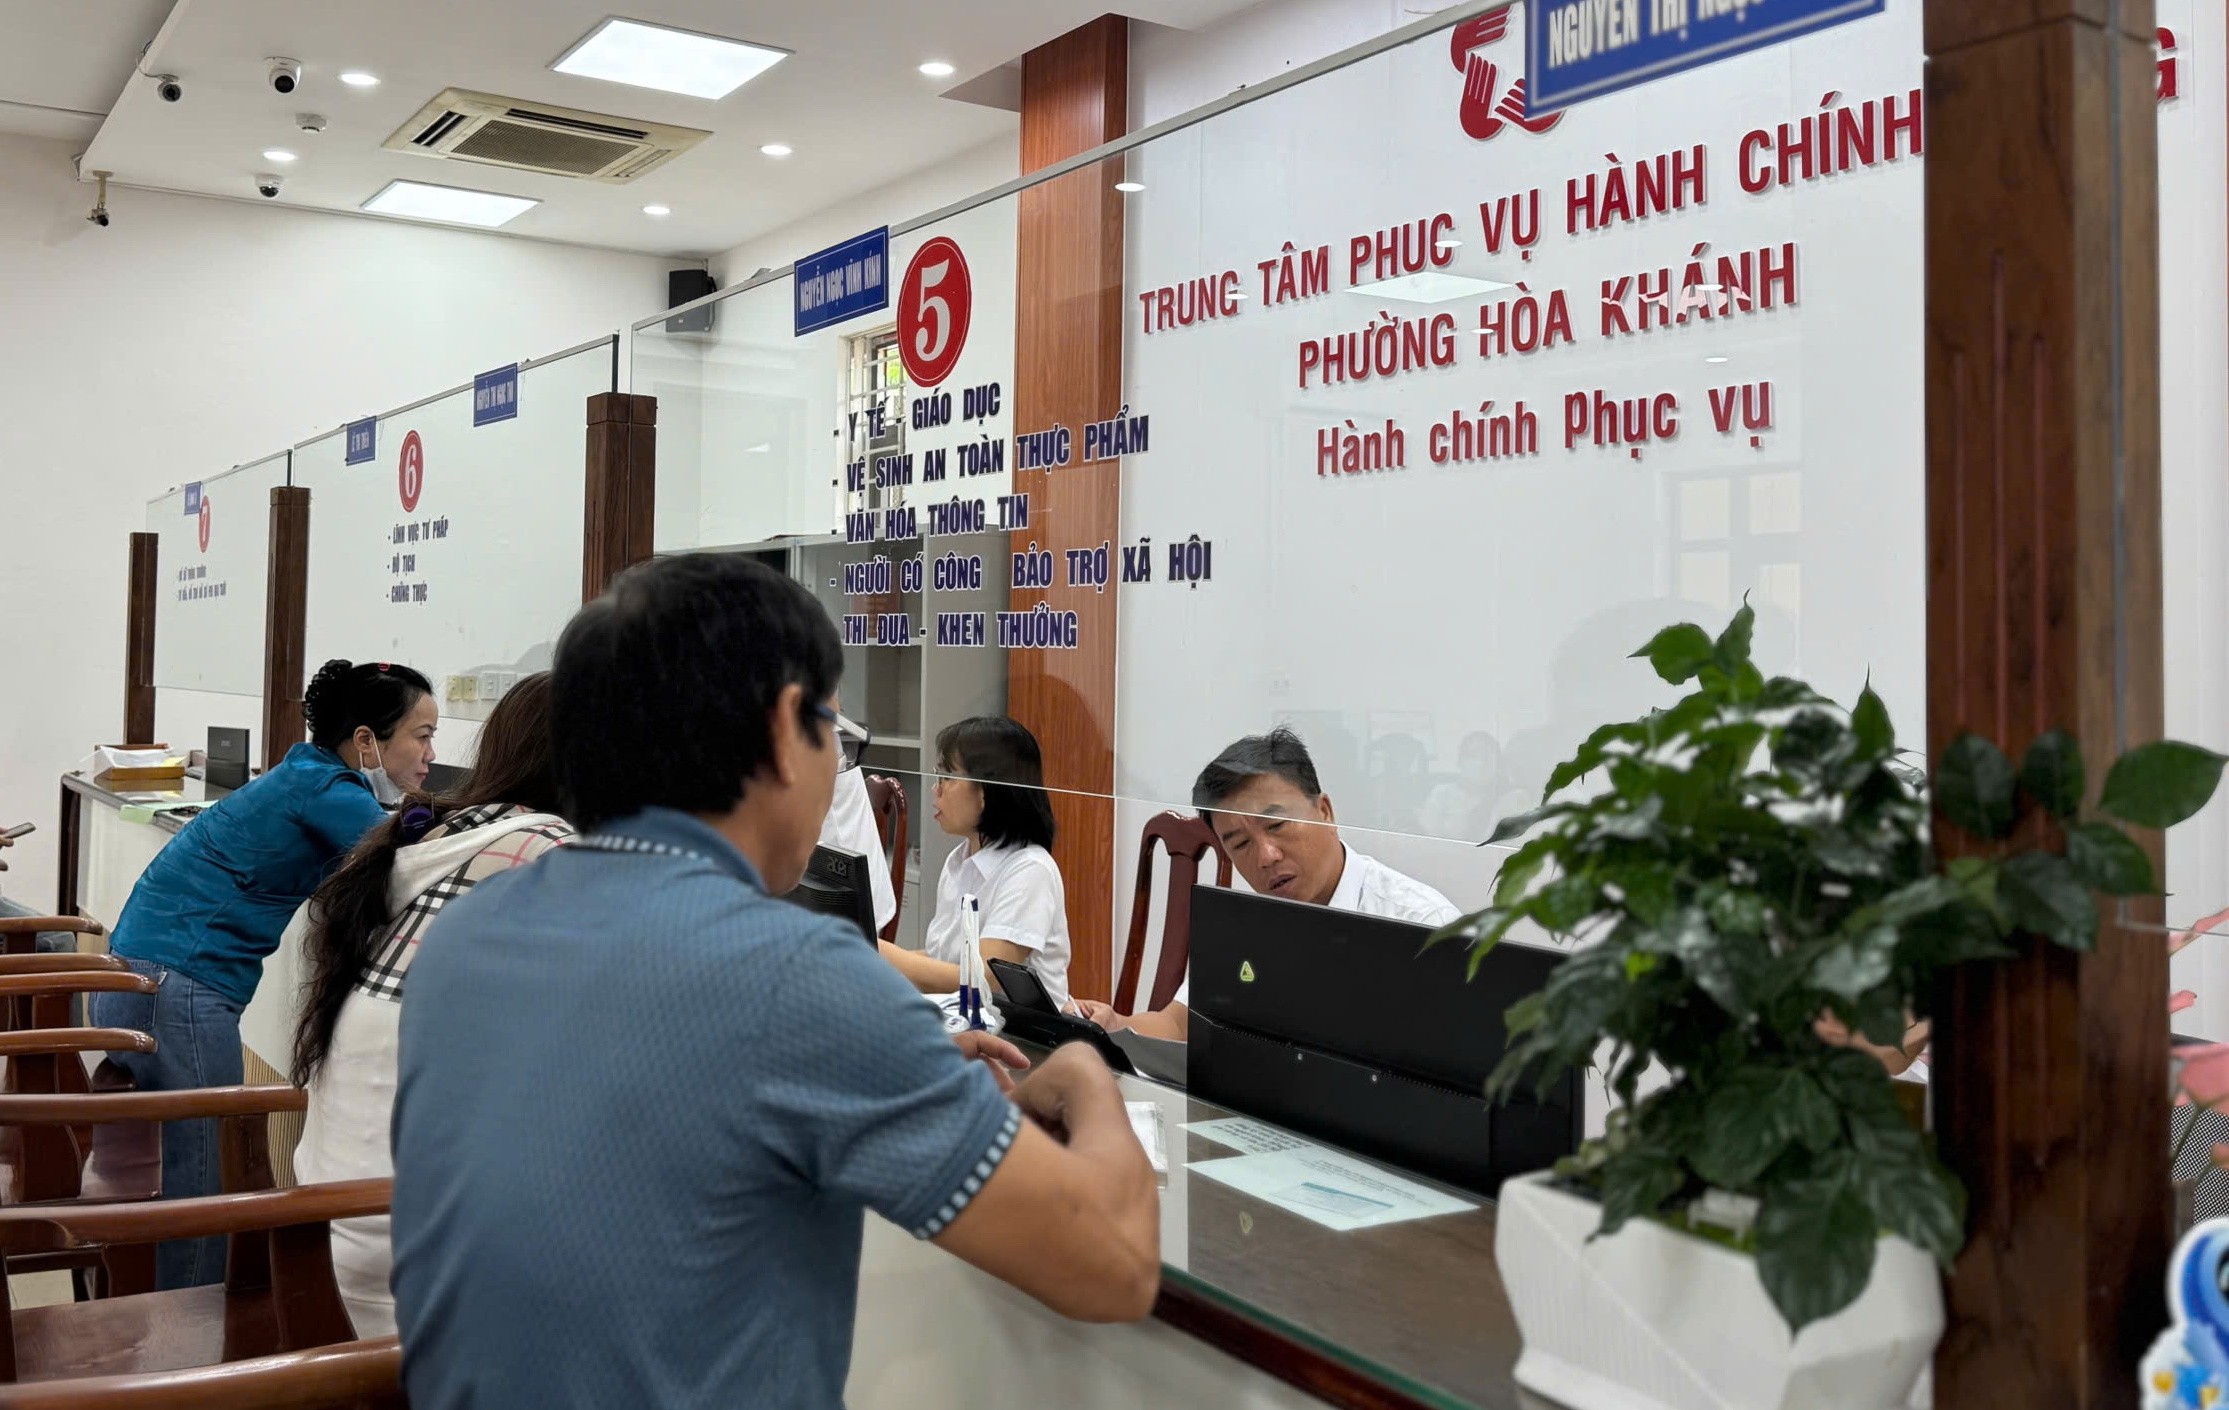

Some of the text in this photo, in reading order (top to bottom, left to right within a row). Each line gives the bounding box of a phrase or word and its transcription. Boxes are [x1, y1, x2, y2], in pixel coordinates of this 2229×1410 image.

[1139, 270, 1240, 334] TRUNG
[1258, 241, 1330, 306] TÂM
[1480, 188, 1541, 261] VỤ
[1567, 143, 1707, 235] HÀNH
[1739, 88, 1924, 195] CHÍNH
[915, 259, 951, 362] 5
[1299, 241, 1798, 388] PHƯỜNG HÒA KHÁNH
[848, 411, 859, 442] Y
[864, 396, 890, 440] TẾ
[912, 387, 951, 431] GIÁO
[963, 382, 1000, 426] DỤC
[1317, 418, 1406, 476] Hành
[1429, 400, 1539, 464] chính
[1708, 380, 1774, 447] vụ
[405, 444, 417, 498] 6
[846, 404, 1149, 497] VỆ SINH AN TOÀN THỰC PHẨM
[845, 493, 1029, 544] VĂN HÓA THÔNG TIN
[844, 534, 1212, 594] NGƯỜI CÓ CÔNG BẢO TRỢ XÃ HỘI
[843, 614, 868, 645] THI
[877, 613, 910, 646] ĐUA
[937, 612, 985, 647] KHEN
[996, 600, 1078, 649] THƯỞNG
